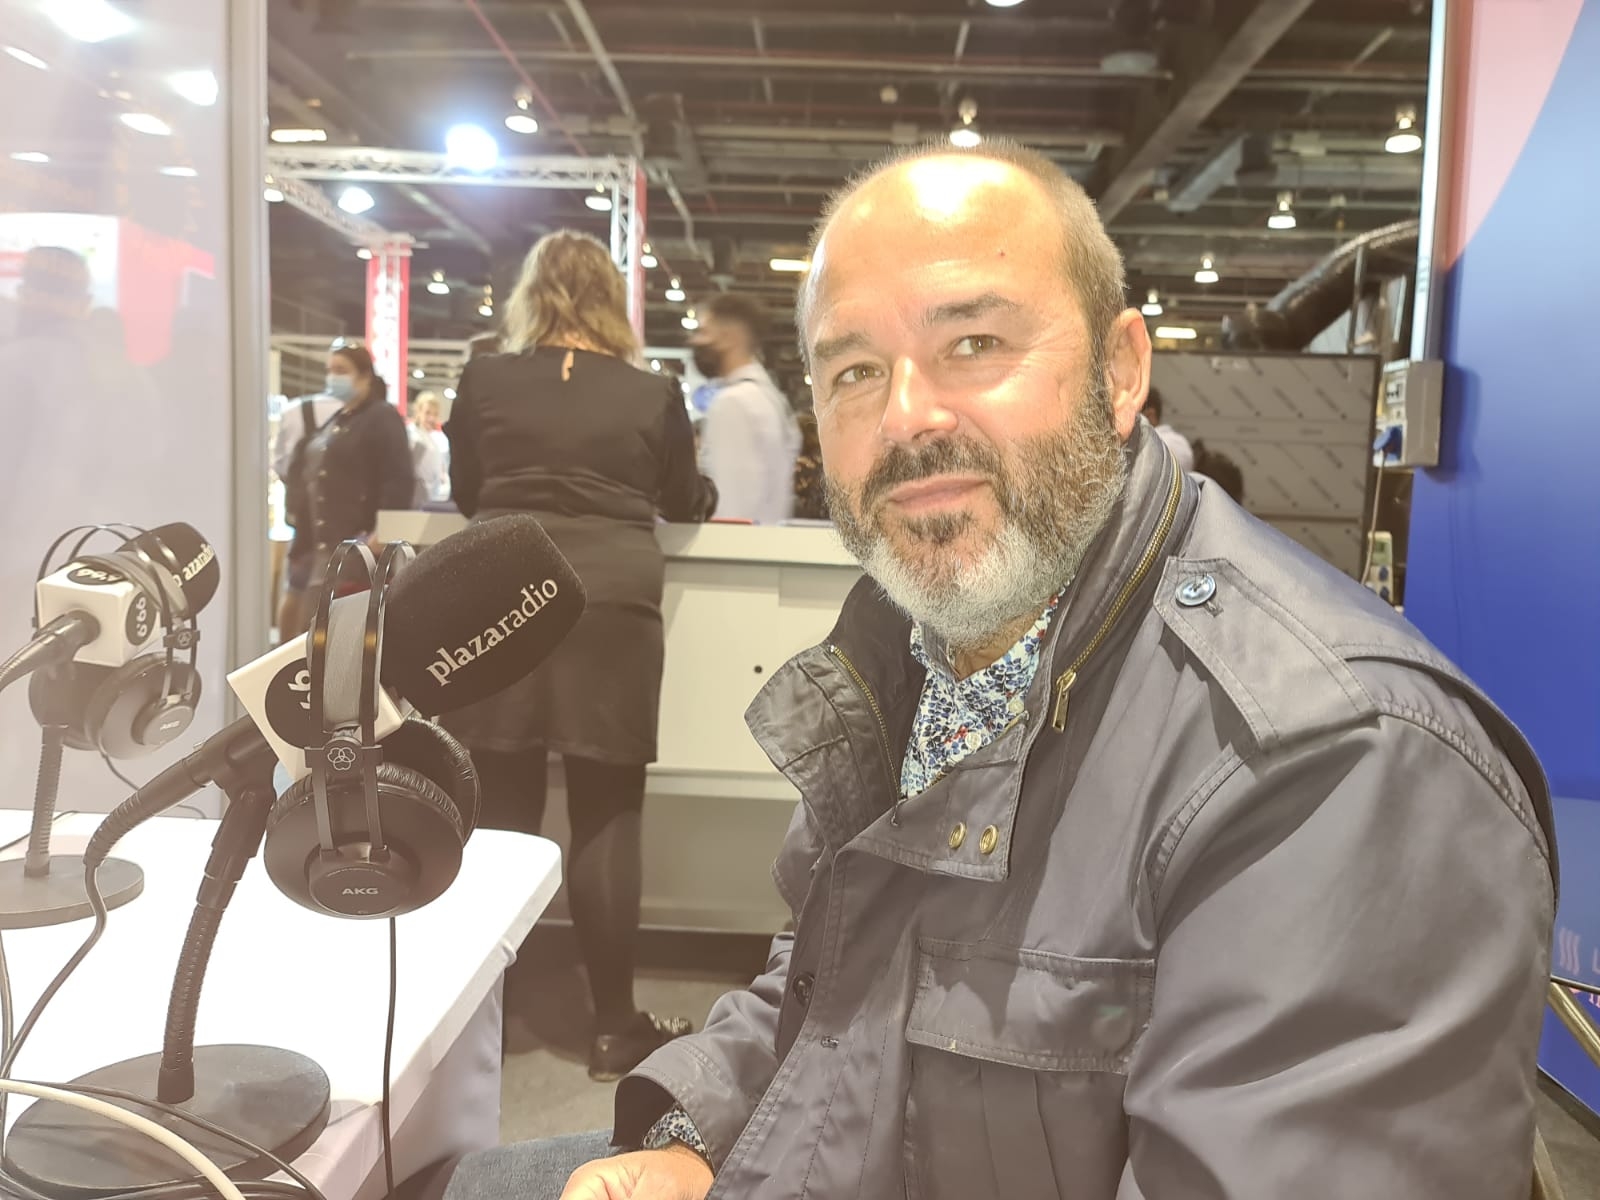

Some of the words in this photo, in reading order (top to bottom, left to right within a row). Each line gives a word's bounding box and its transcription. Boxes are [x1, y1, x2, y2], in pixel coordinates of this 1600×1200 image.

[136, 597, 148, 637] 99.9
[425, 579, 558, 687] plazaradio
[342, 887, 379, 895] AKG
